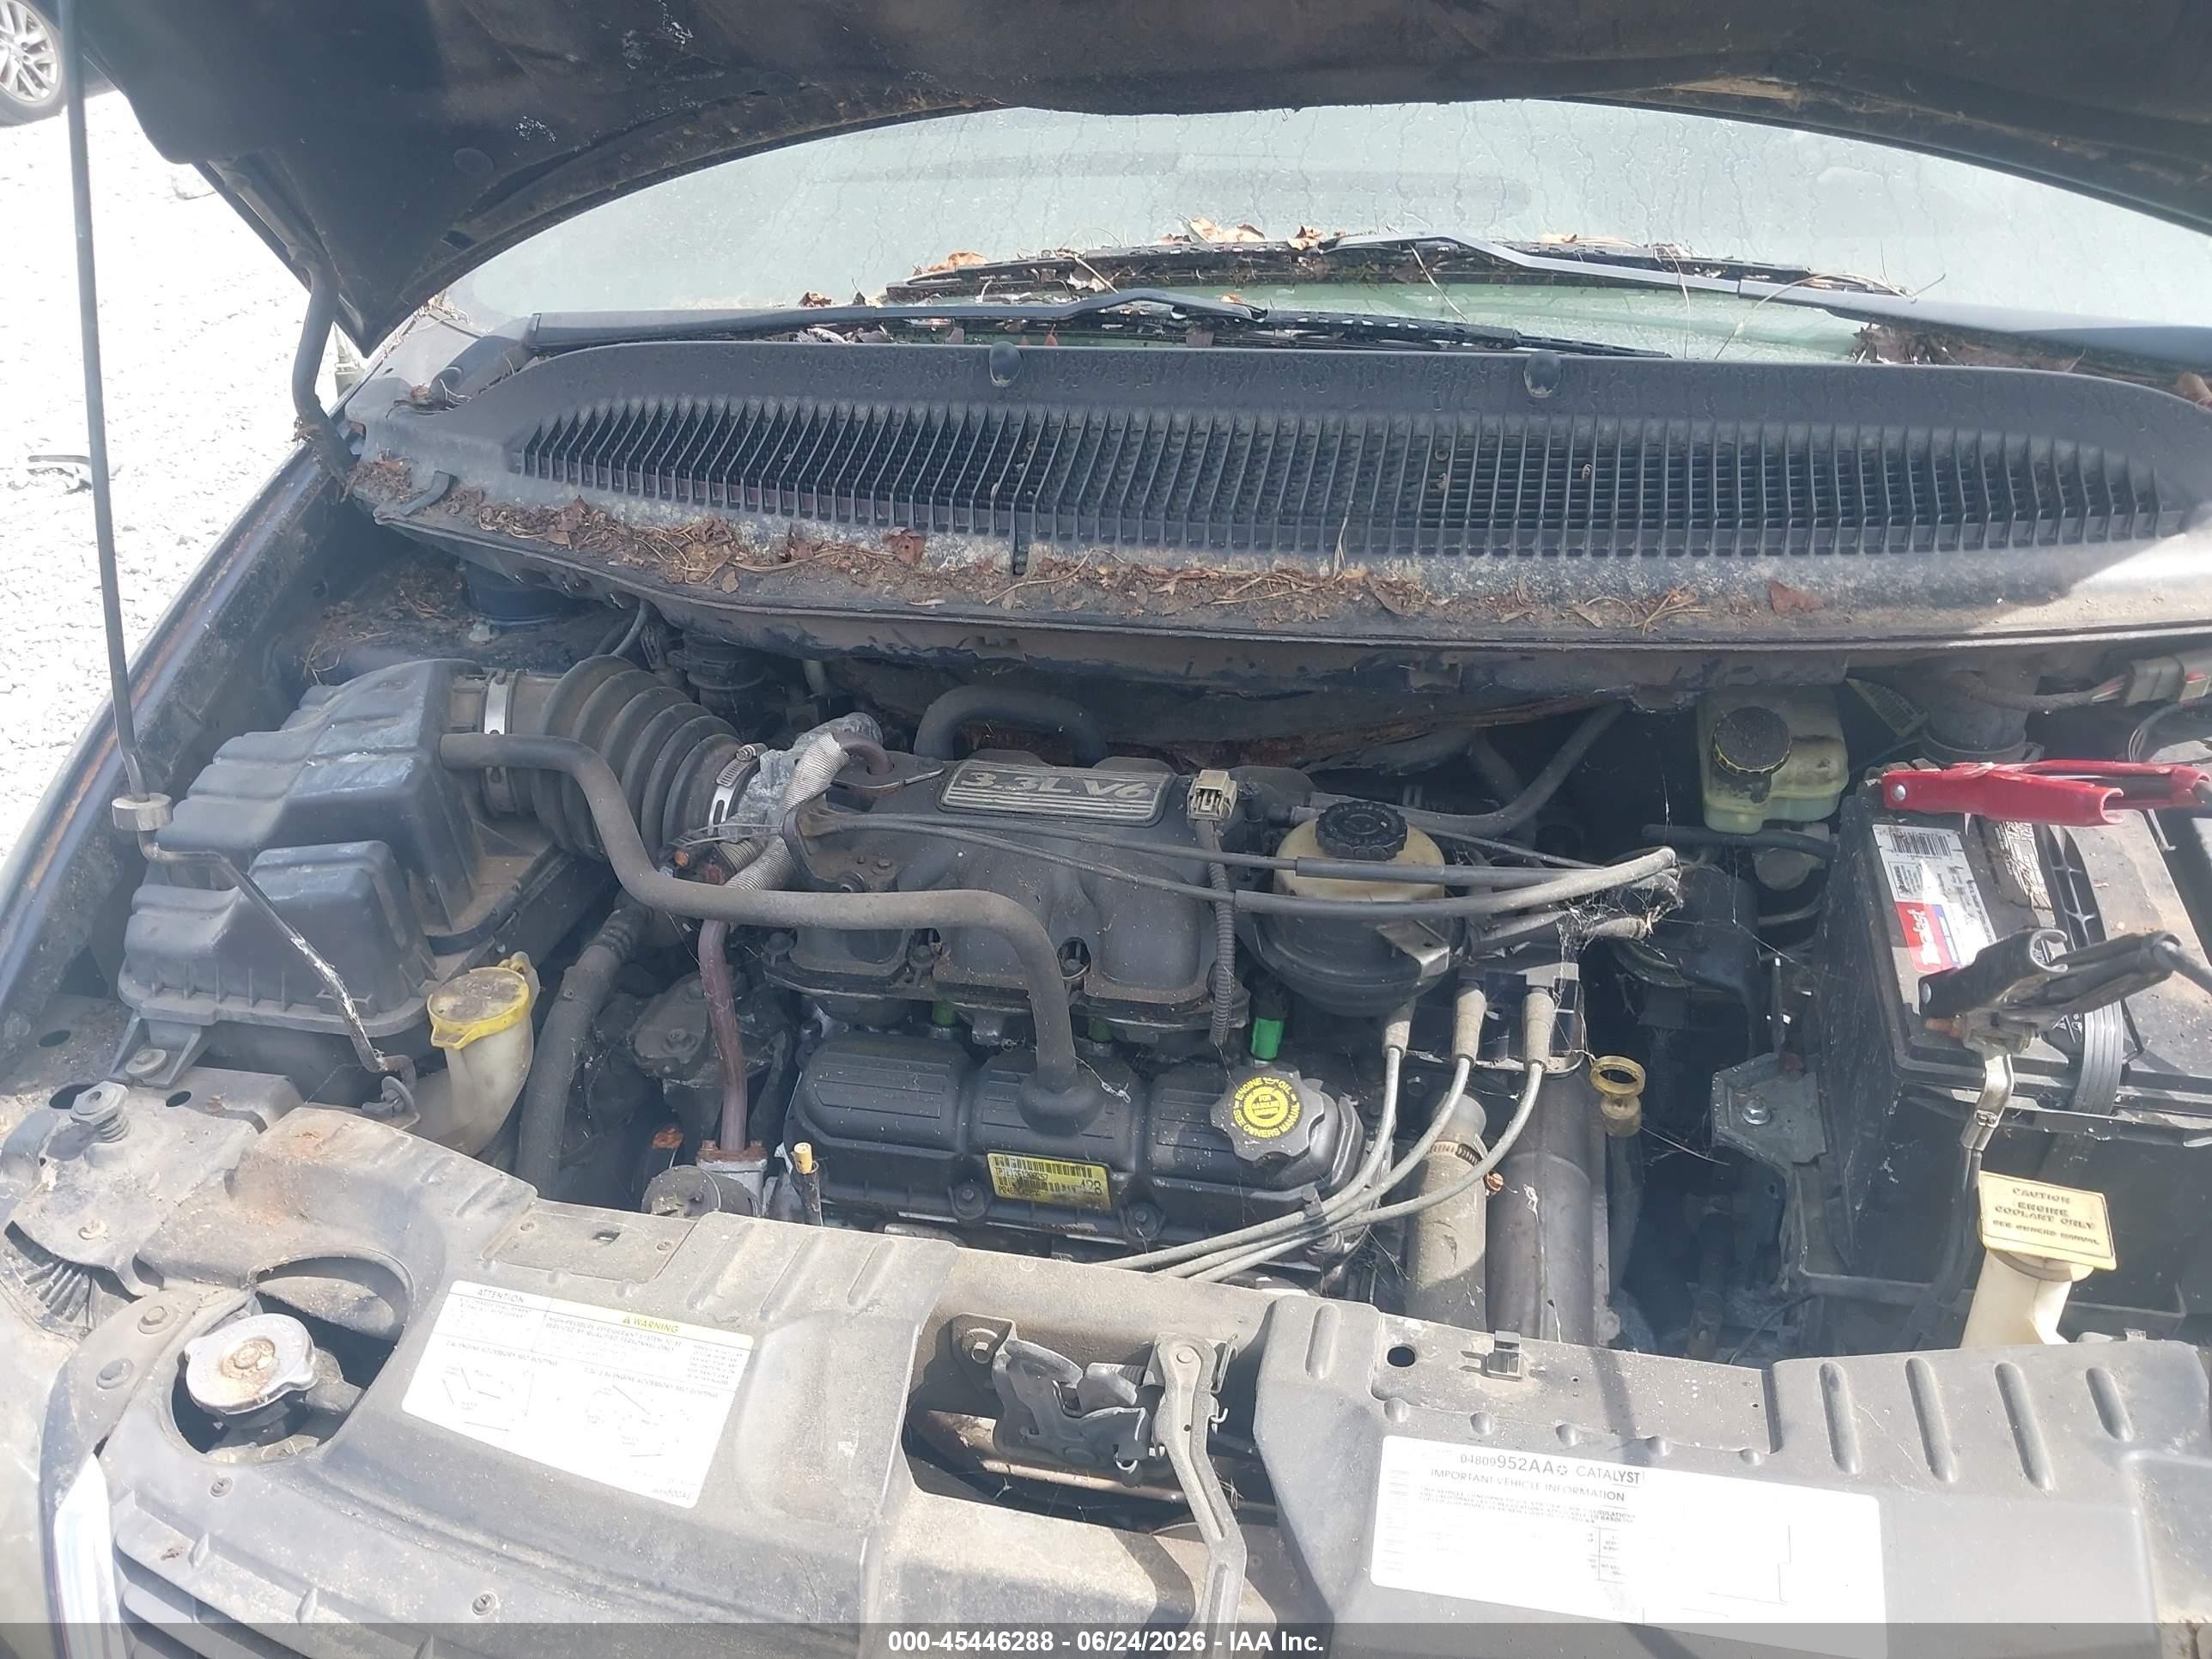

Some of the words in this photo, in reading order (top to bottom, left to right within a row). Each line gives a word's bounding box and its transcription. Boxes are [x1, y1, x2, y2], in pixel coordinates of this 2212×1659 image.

[962, 773, 1073, 793] 3.3L
[1084, 779, 1151, 799] V6
[1235, 1077, 1263, 1100] ENGINE
[1278, 1080, 1291, 1095] OIL
[1232, 1109, 1247, 1127] SEE
[1279, 1102, 1300, 1133] MANUAL
[2012, 1188, 2070, 1204] CAUTION
[1995, 1206, 2055, 1223] COOLANT
[2061, 1218, 2094, 1230] ONLY
[2017, 1201, 2069, 1217] ENGINE
[477, 1289, 526, 1304] ATTENTION
[634, 1318, 679, 1334] WARNING
[1460, 1453, 1554, 1475] 04809952AA
[1576, 1465, 1640, 1485] CATALYST
[1431, 1468, 1492, 1484] IMPORTANT
[1497, 1475, 1540, 1491] VEHICLE
[1545, 1483, 1625, 1501] INFORMATION
